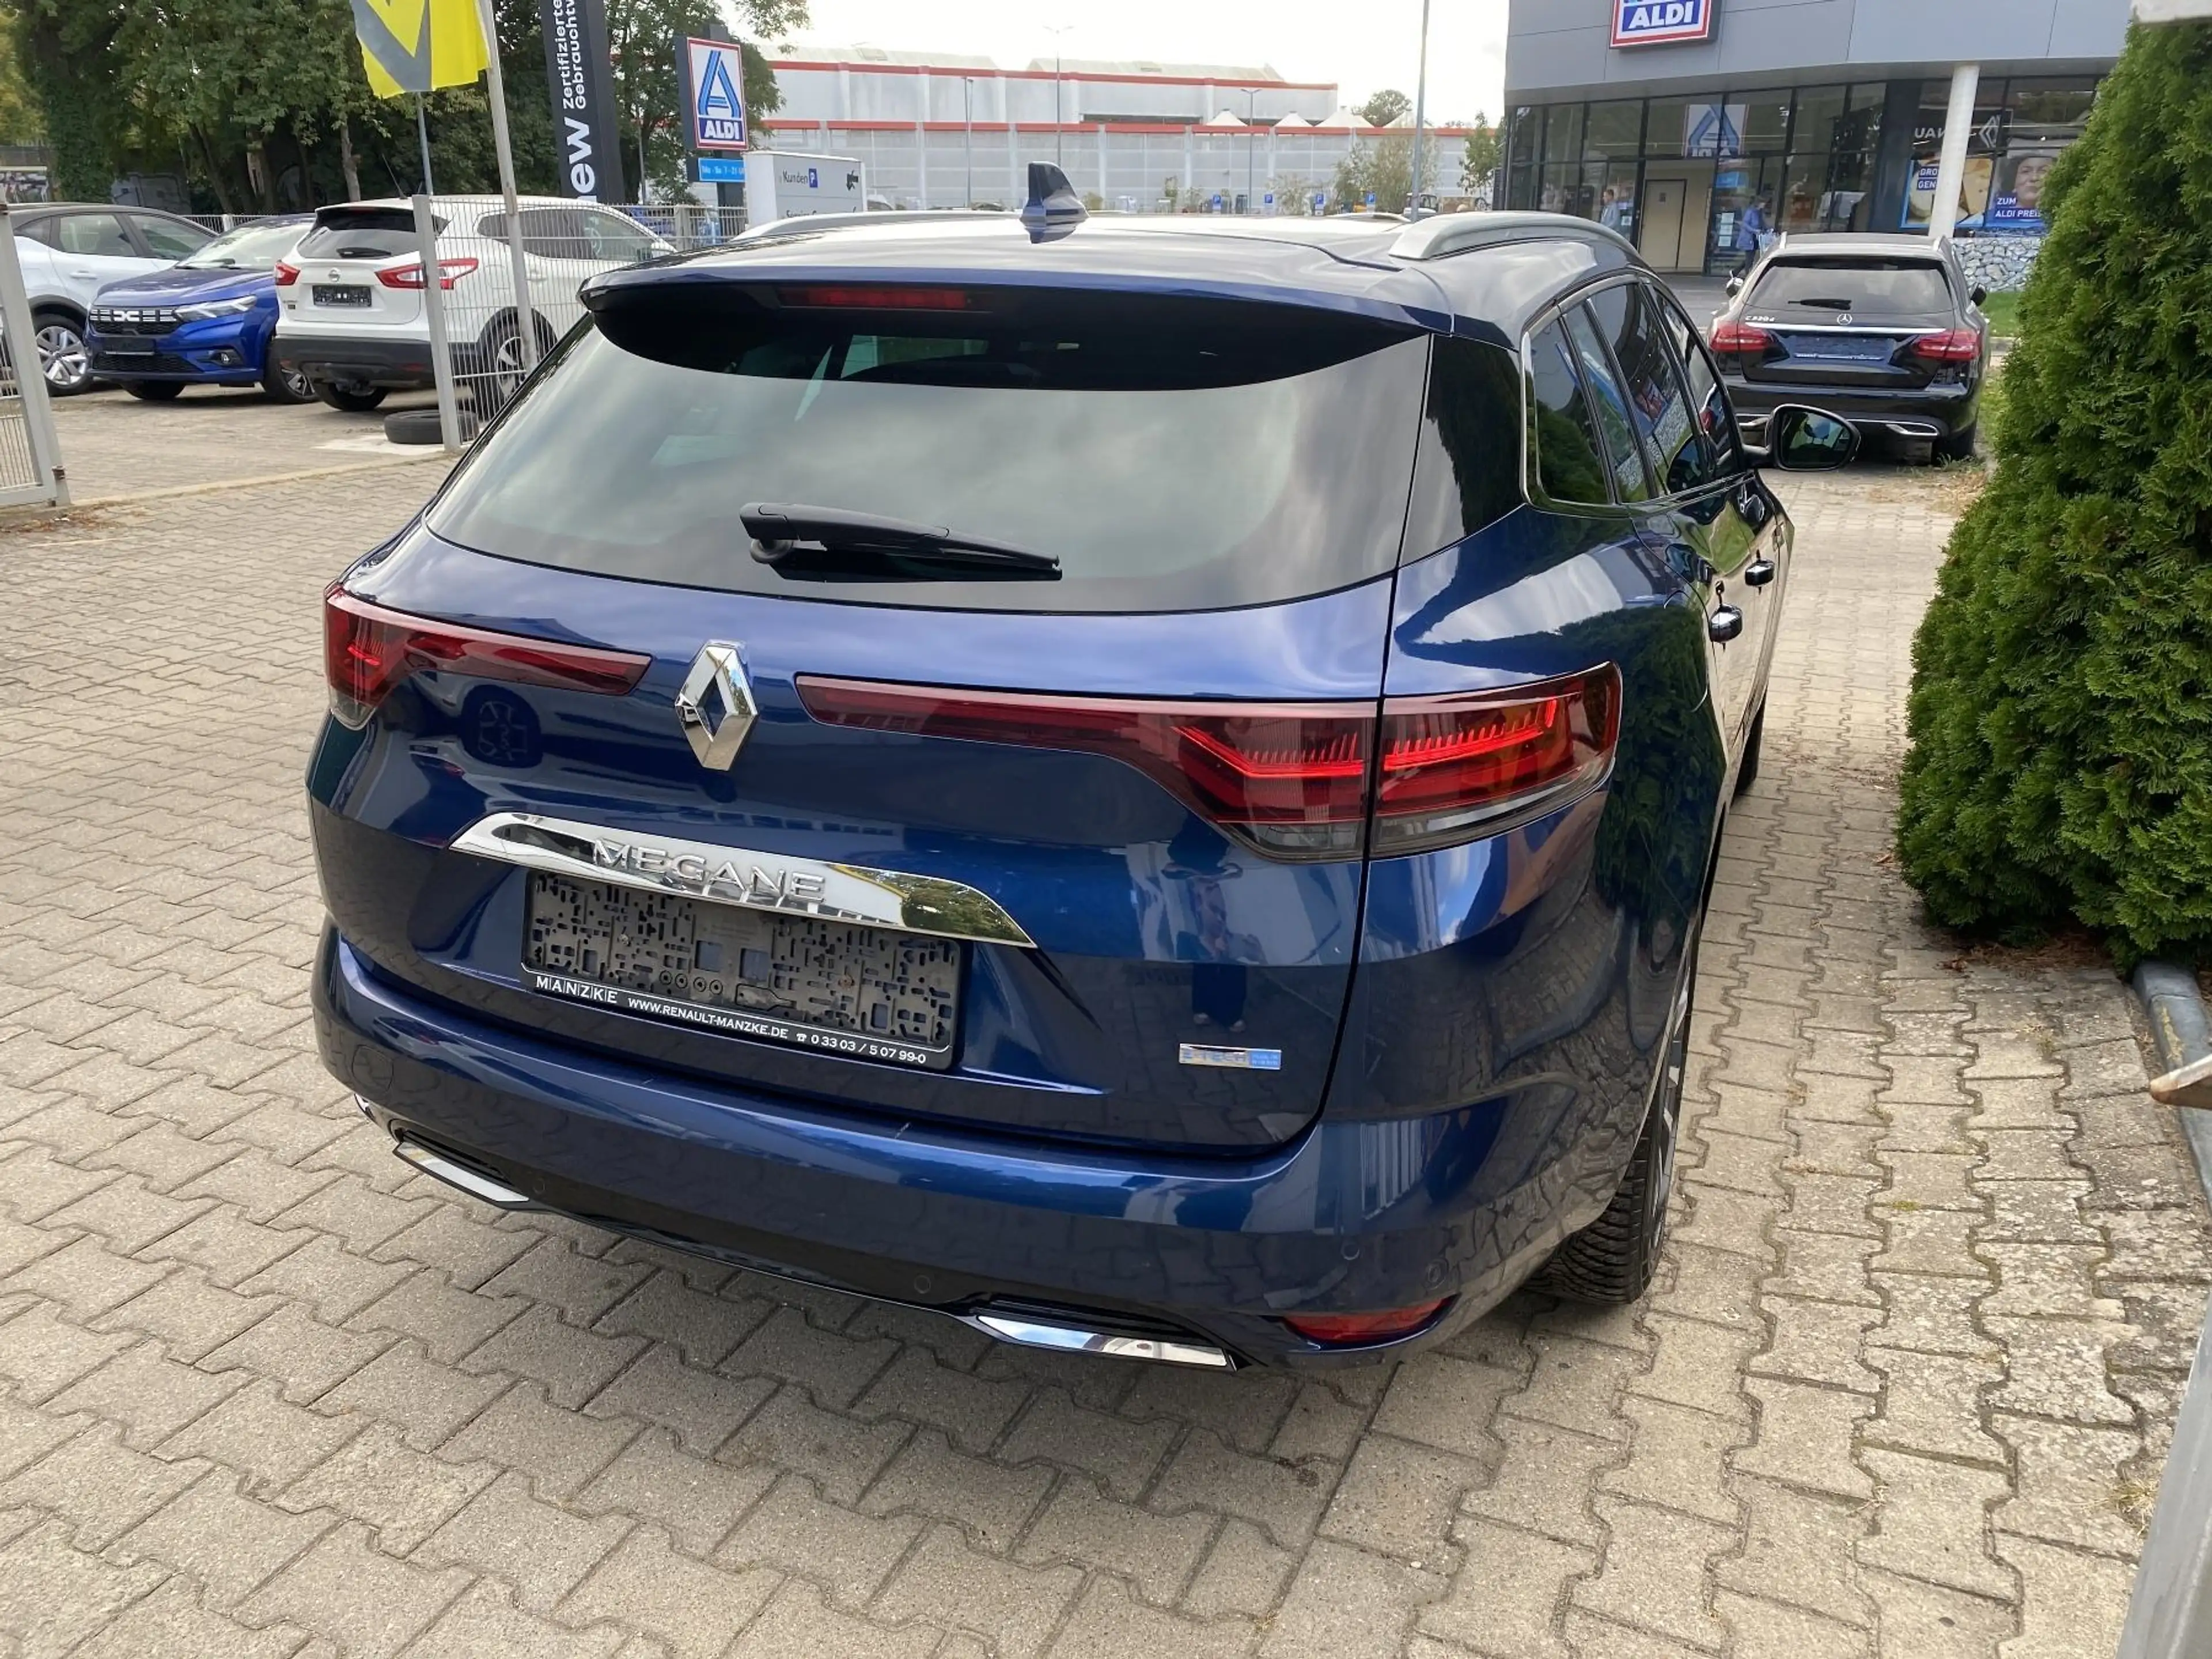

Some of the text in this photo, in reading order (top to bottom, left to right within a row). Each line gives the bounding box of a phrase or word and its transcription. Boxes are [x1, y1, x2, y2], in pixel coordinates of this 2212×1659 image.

[1628, 1, 1694, 29] ALDI
[704, 120, 740, 139] ALDI
[782, 169, 808, 184] Kunden
[1997, 197, 2016, 205] ZUM
[593, 837, 825, 901] MEGANE
[628, 998, 789, 1040] WWW.RENAULT-MANZKE.DE
